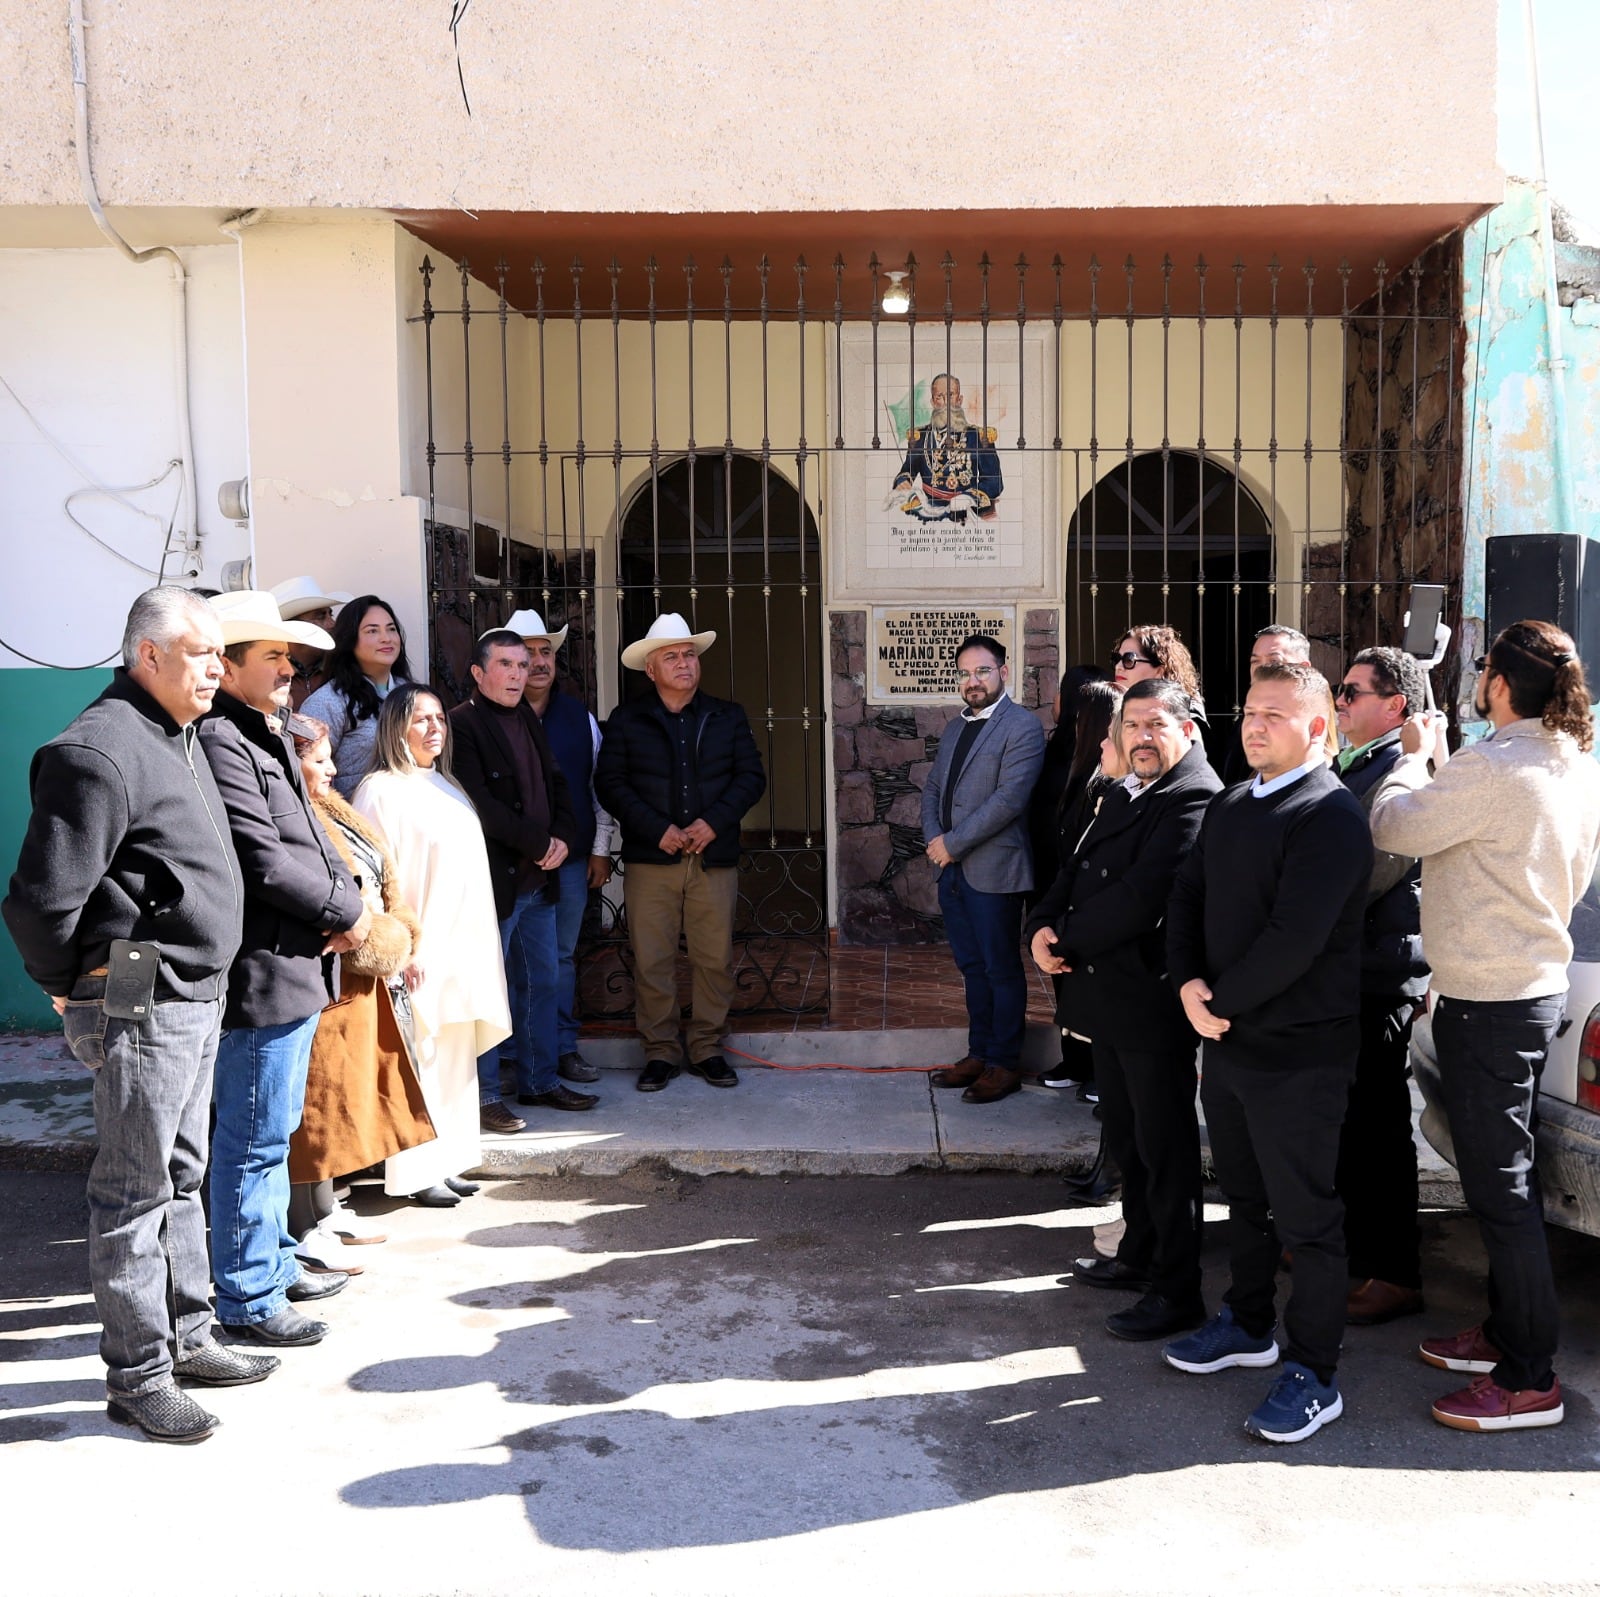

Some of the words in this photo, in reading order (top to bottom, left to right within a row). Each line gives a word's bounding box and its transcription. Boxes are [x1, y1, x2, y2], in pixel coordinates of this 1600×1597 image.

[910, 612, 921, 620] EN
[924, 612, 946, 620] ESTE
[886, 620, 896, 628] EL
[900, 620, 913, 628] DIA
[915, 620, 924, 628] 16
[927, 620, 938, 628] DE
[941, 620, 968, 628] ENERO
[971, 620, 981, 628] DE
[889, 629, 914, 637] NACIO
[932, 629, 949, 637] QUE
[972, 628, 1000, 636] TARDE
[897, 637, 916, 645] FUE
[920, 637, 960, 645] ILUSTRE
[879, 645, 935, 660] MARIANO
[895, 669, 907, 677] LE
[910, 669, 937, 677] RINDE
